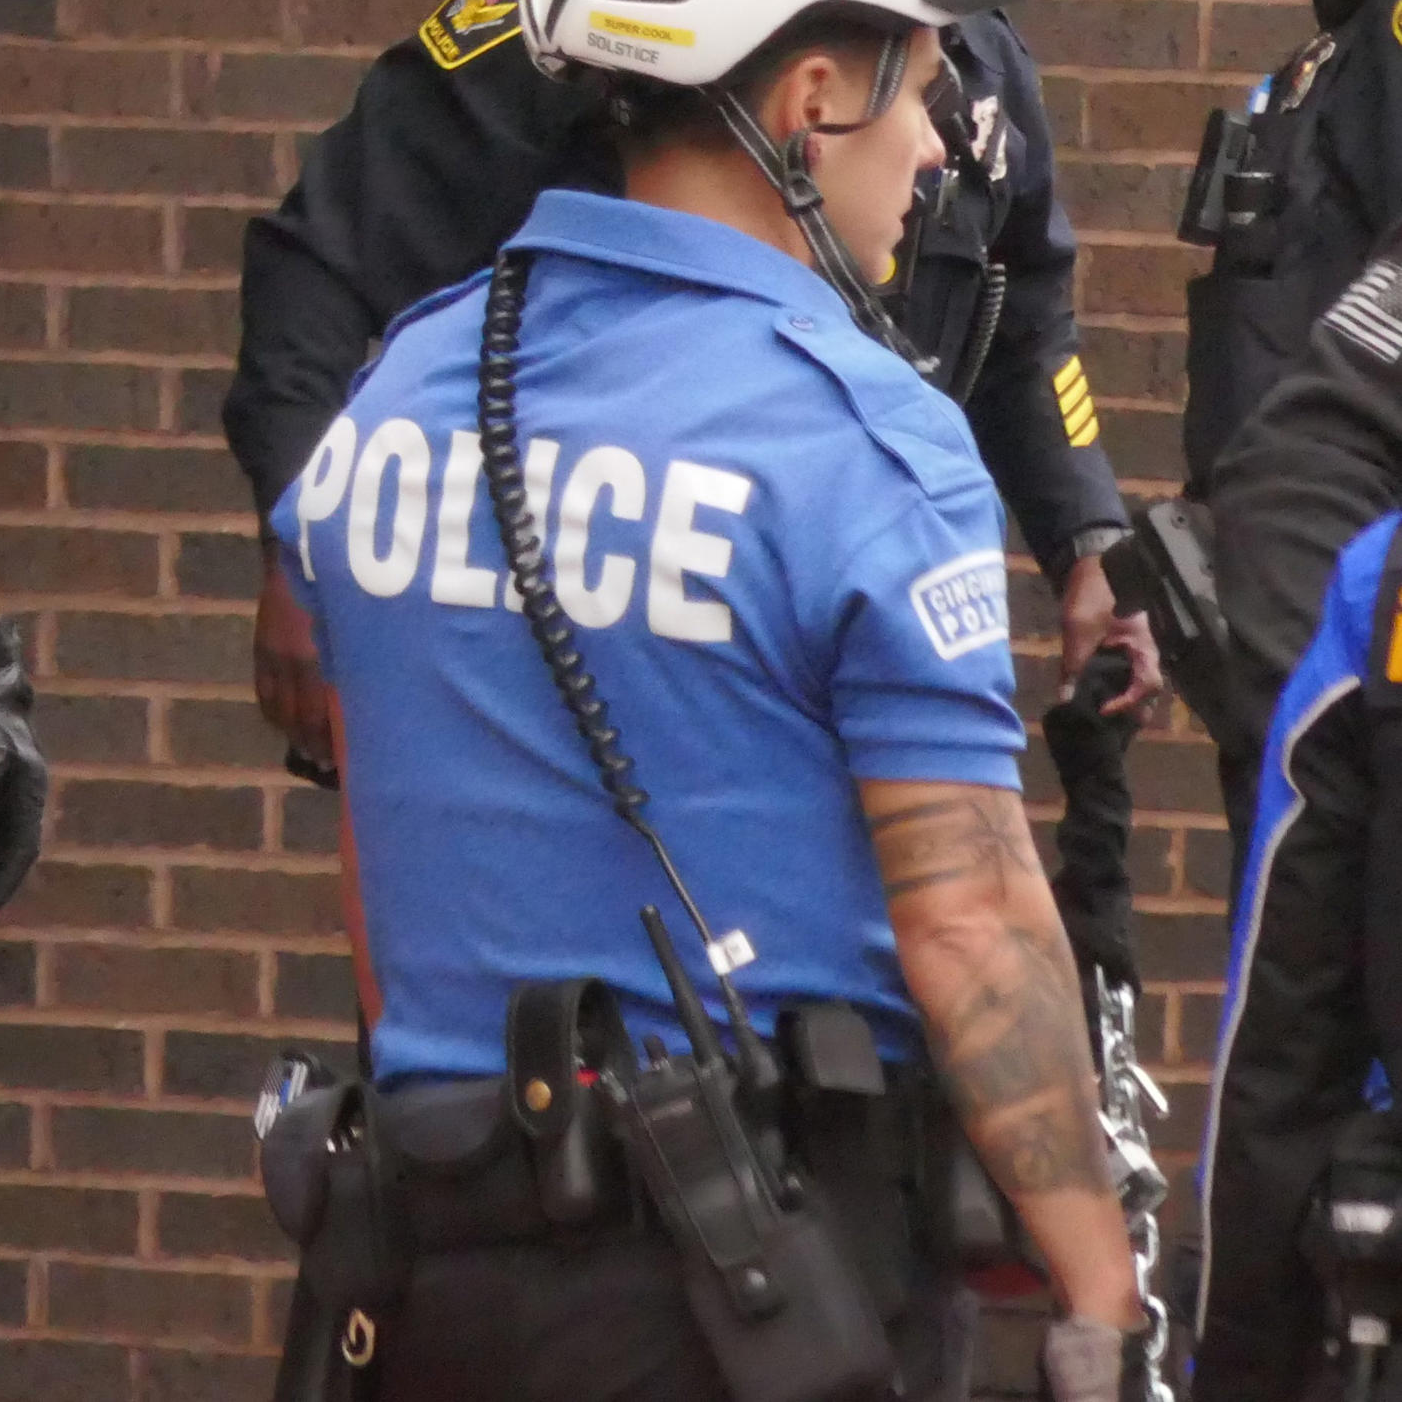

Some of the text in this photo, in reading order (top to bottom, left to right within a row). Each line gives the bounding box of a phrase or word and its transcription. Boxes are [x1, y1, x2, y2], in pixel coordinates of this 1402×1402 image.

[604, 17, 673, 41] SUPER COOL
[587, 32, 660, 65] SOLSTICE
[297, 415, 752, 643] POLICE
